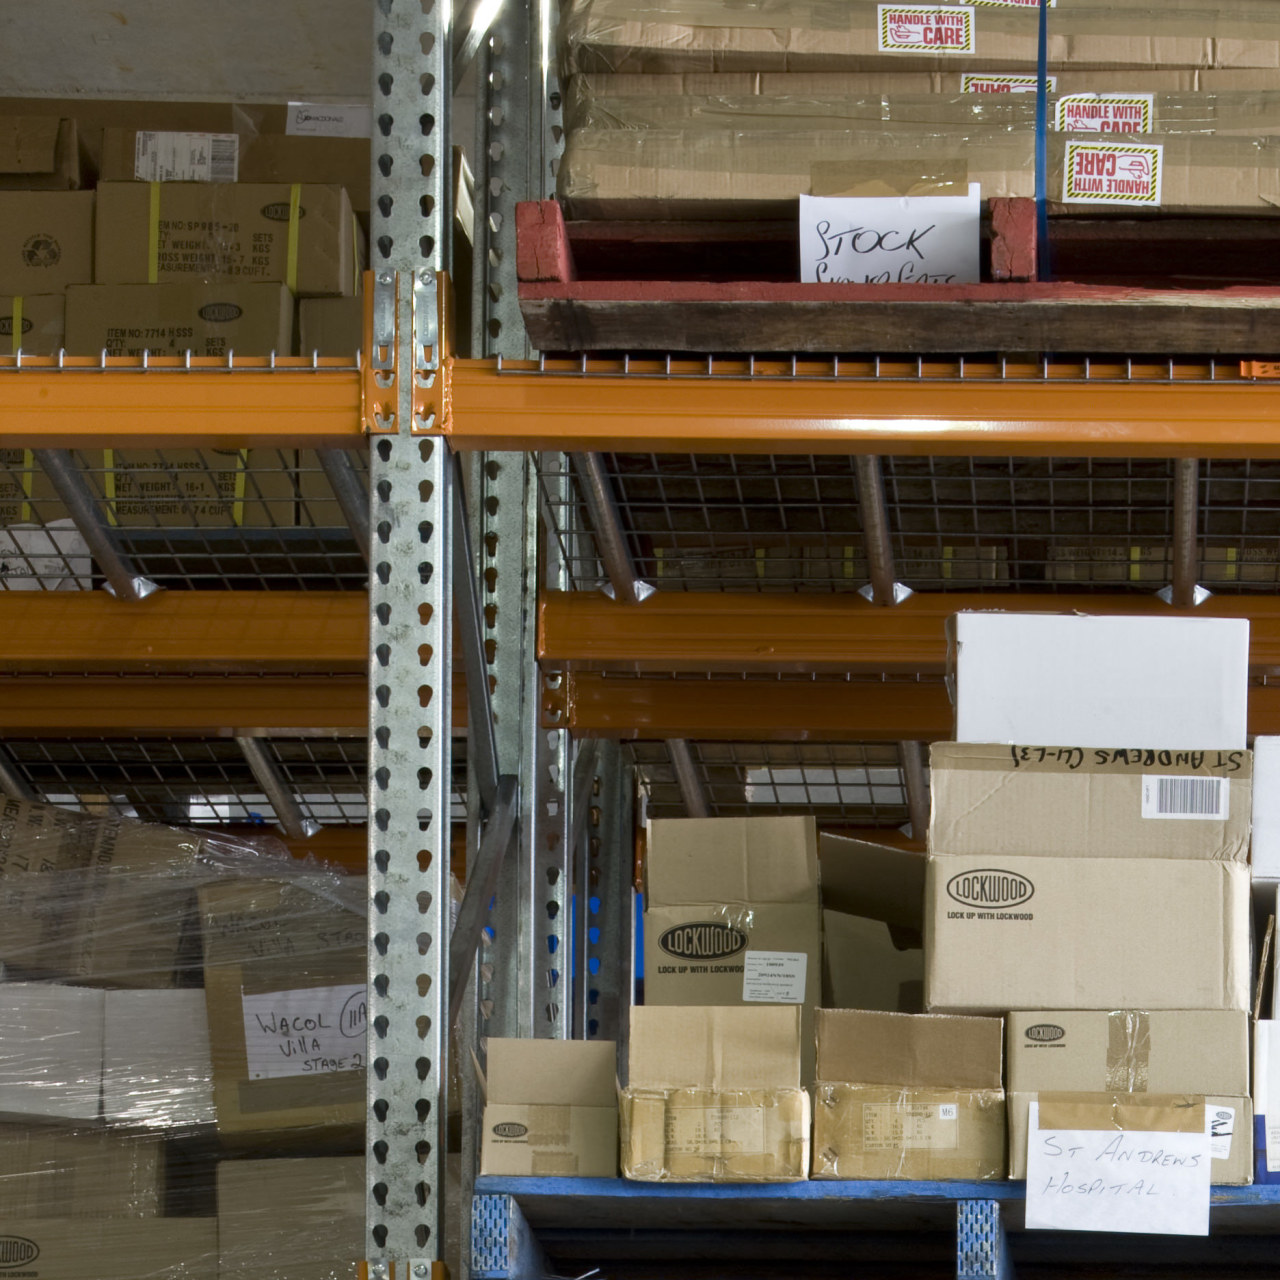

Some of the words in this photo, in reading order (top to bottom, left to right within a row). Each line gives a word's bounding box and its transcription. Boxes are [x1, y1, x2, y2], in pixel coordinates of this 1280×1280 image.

[889, 15, 931, 26] HANDLE
[934, 15, 963, 26] WITH
[923, 27, 963, 45] CARE
[1067, 105, 1109, 119] HANDLE
[1113, 106, 1142, 119] WITH
[1076, 153, 1116, 175] CARE
[1074, 178, 1104, 192] WITH
[1106, 180, 1149, 194] HANDLE
[815, 220, 936, 262] STOCK
[1096, 748, 1205, 770] ANDREWS
[956, 876, 1026, 902] LOCKWOOD
[977, 912, 995, 920] WITH
[668, 926, 741, 956] LOCKWOOD
[658, 966, 676, 974] LOCK
[710, 965, 744, 973] LOCKWOO
[1028, 1027, 1063, 1041] LOCKWOOD
[351, 1054, 366, 1069] 2
[1096, 1134, 1201, 1168] ANDREWS
